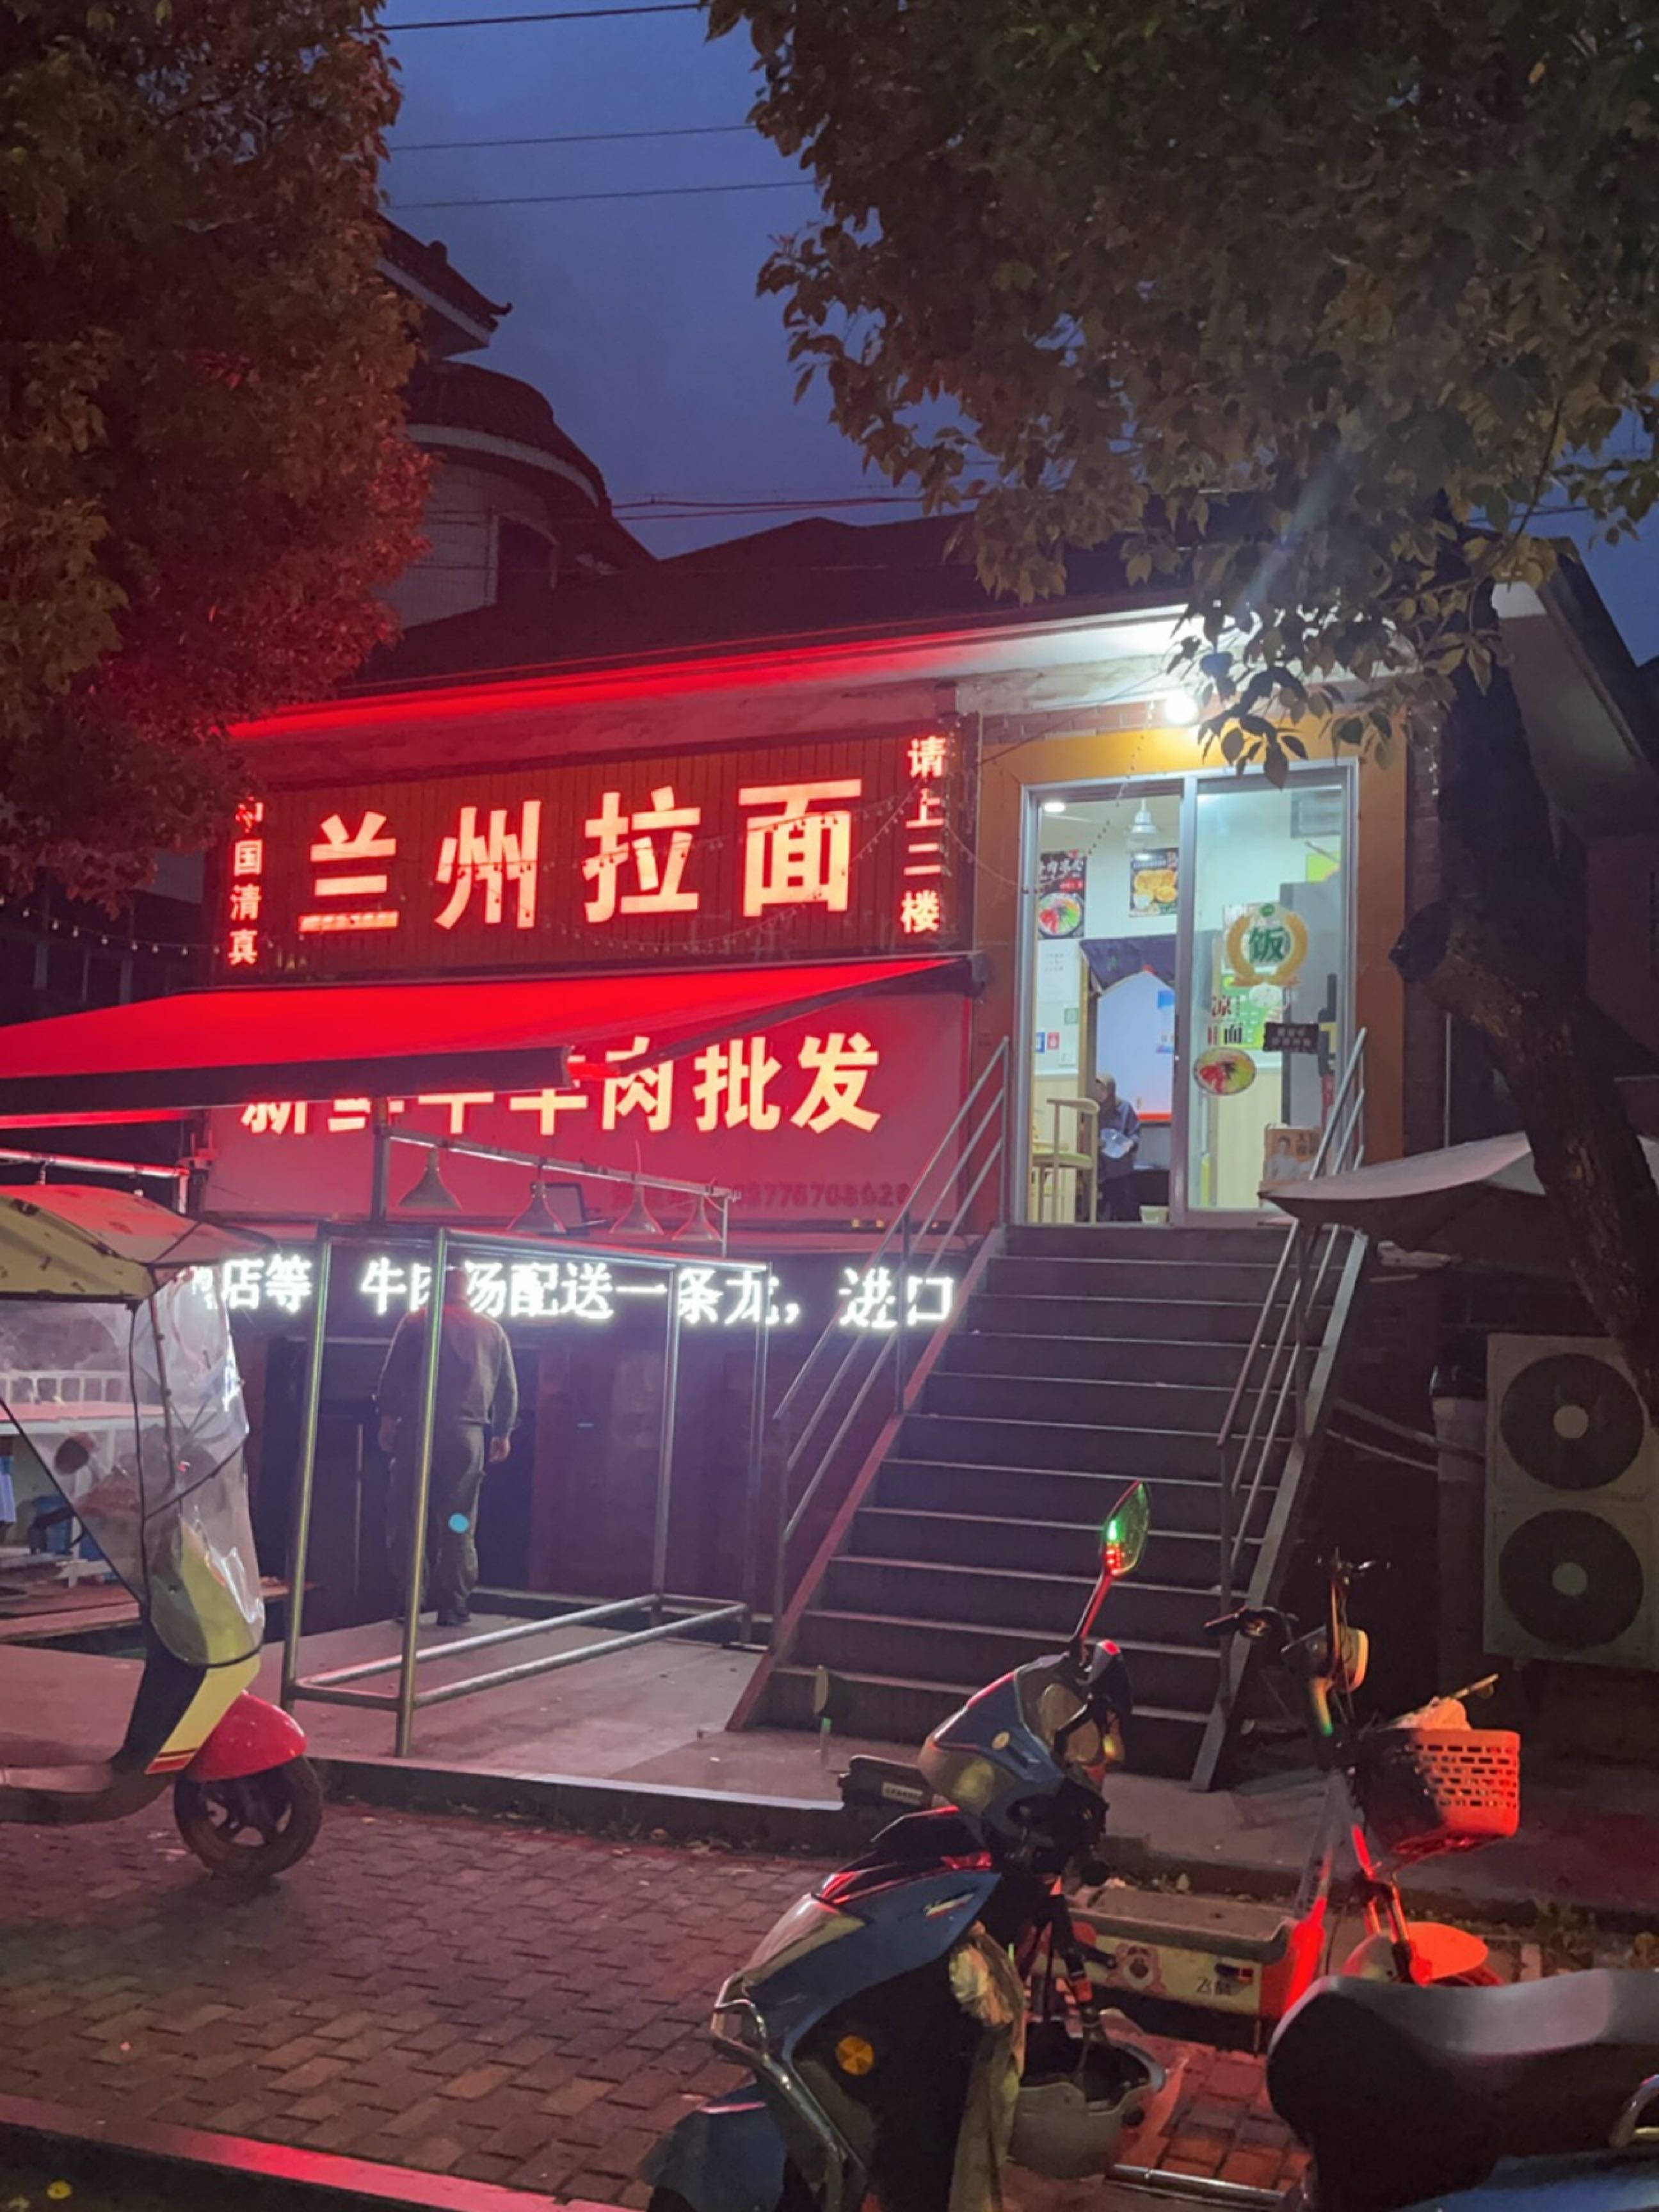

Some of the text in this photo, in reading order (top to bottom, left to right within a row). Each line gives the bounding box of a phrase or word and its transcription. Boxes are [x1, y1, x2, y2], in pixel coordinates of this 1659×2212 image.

[298, 778, 862, 933] 兰州拉面
[901, 735, 947, 933] 请上二楼
[838, 1266, 955, 1328] 进口
